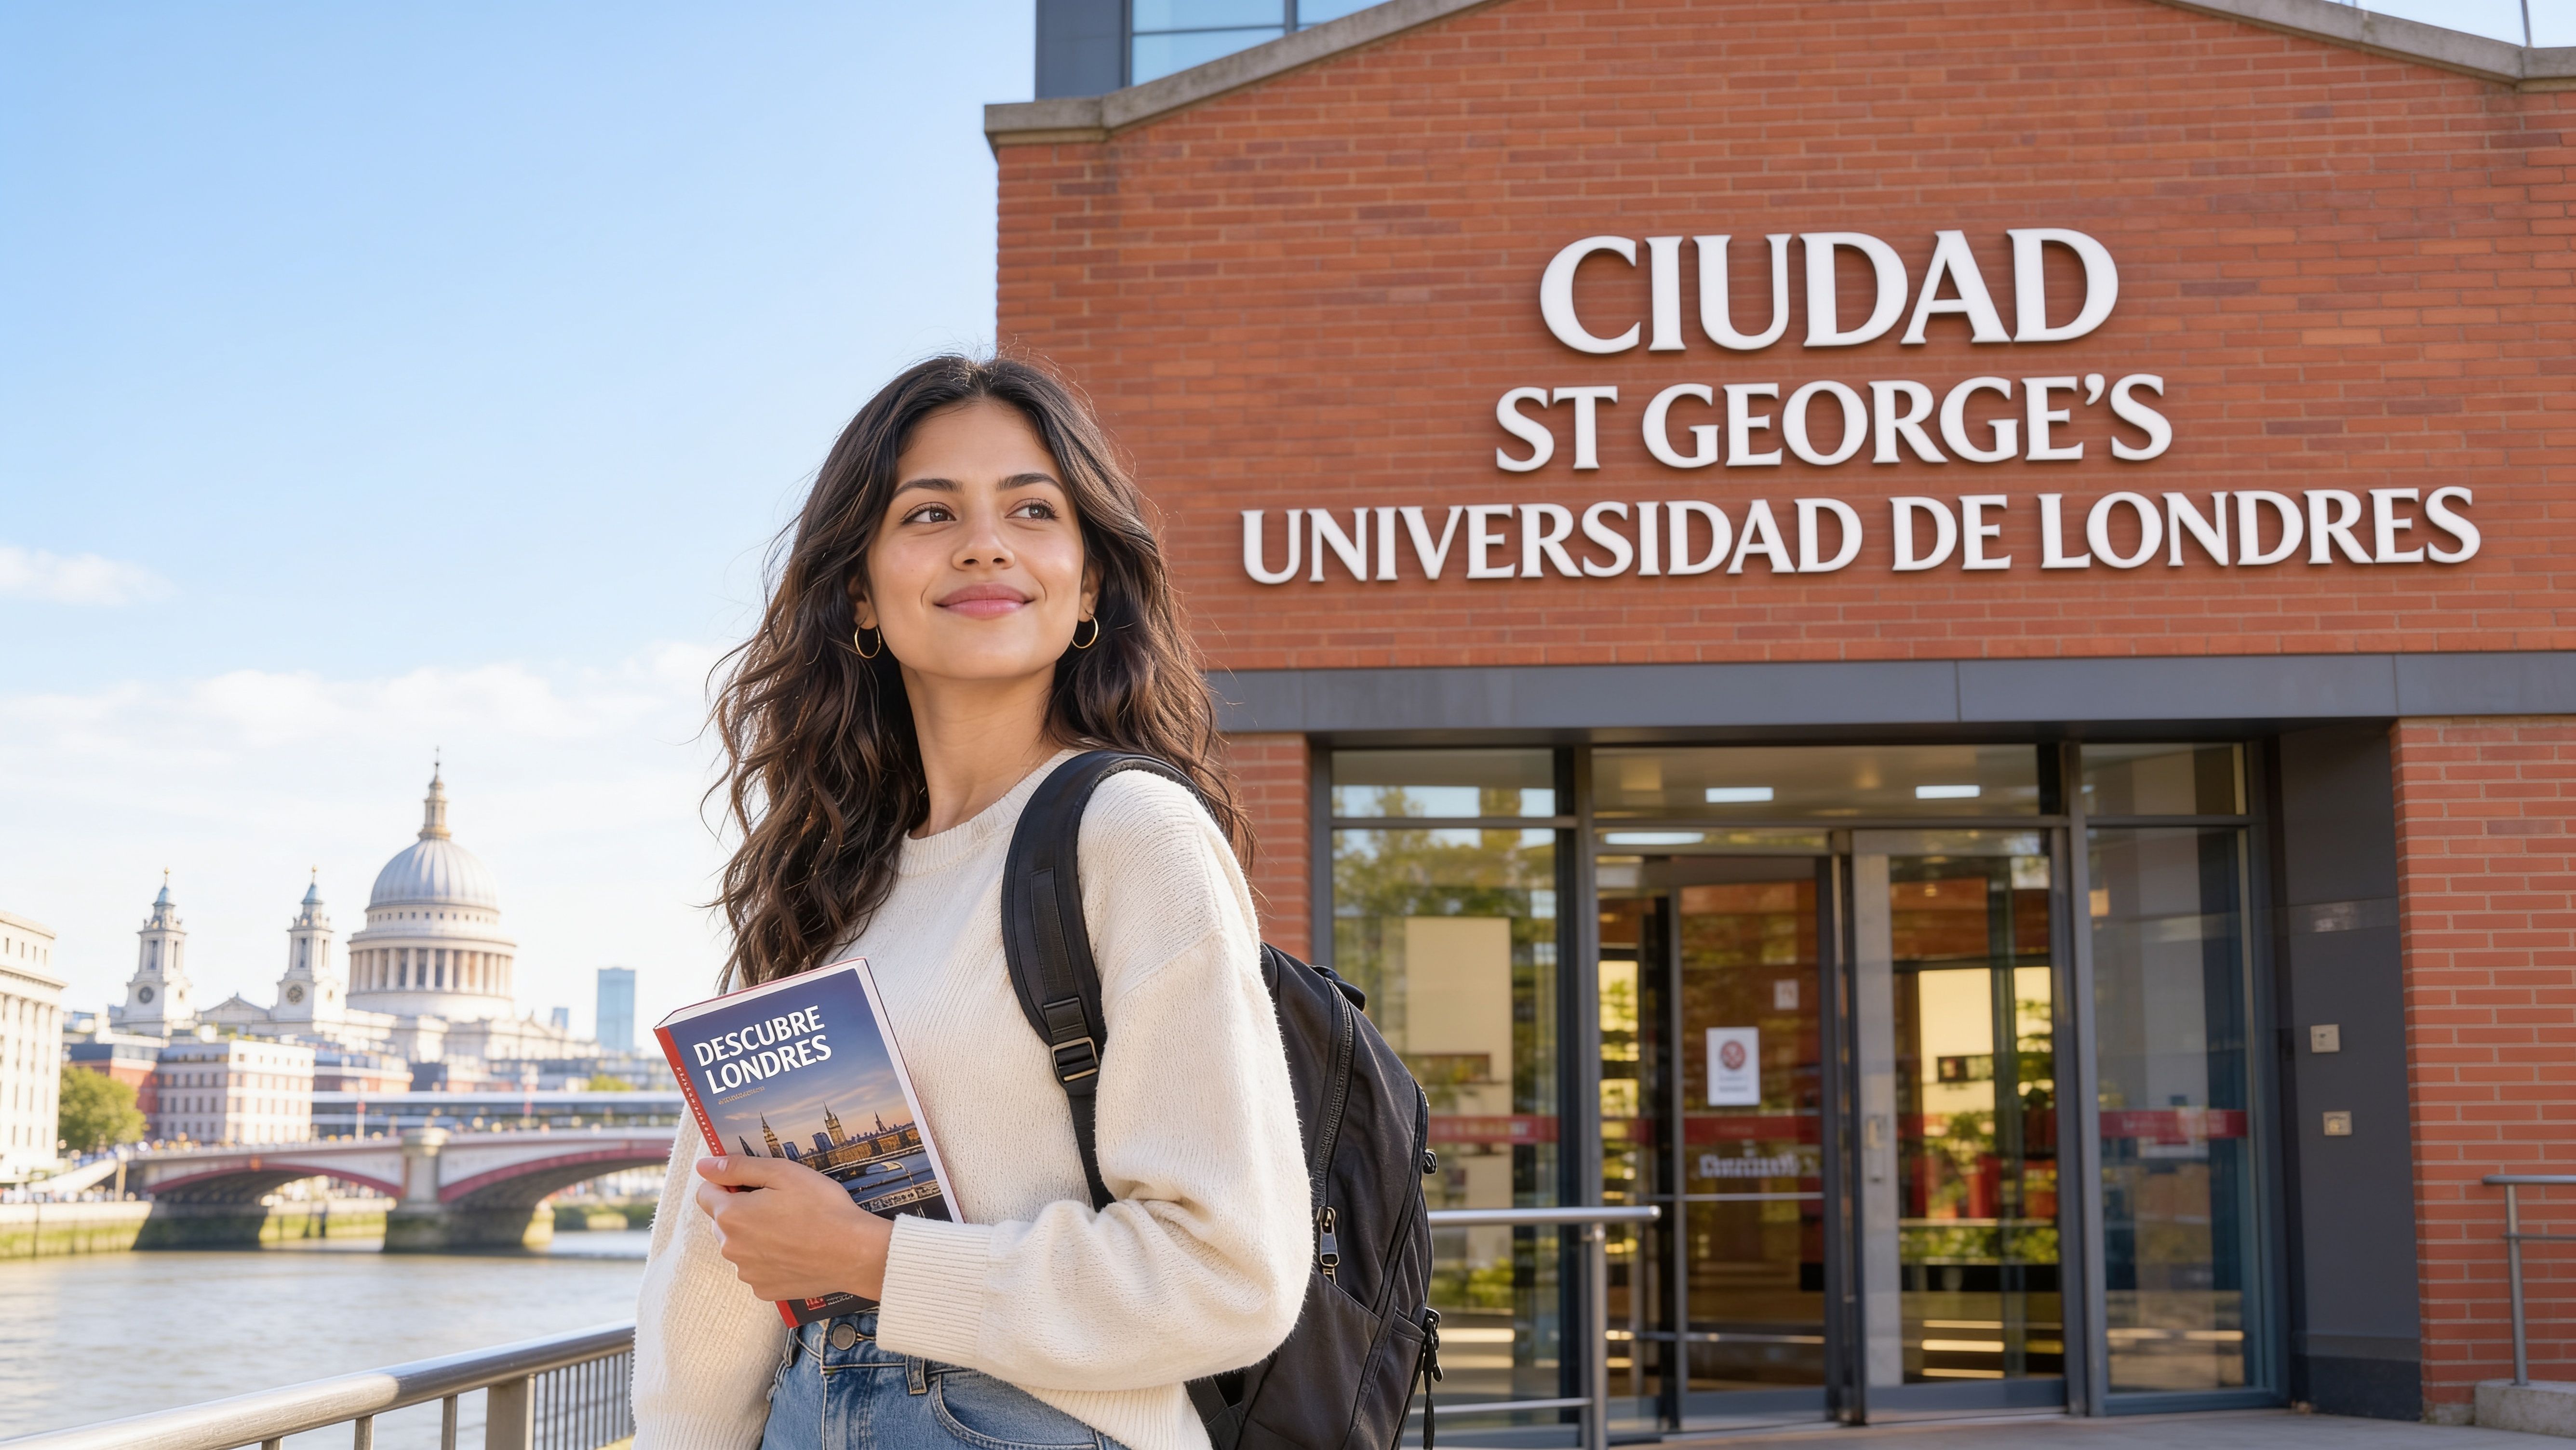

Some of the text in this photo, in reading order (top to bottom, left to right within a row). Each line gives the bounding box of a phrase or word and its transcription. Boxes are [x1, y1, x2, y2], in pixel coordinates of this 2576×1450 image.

[1540, 228, 2119, 354] CIUDAD
[1496, 373, 2173, 472] ST GEORGE’S
[1240, 485, 2482, 584] UNIVERSIDAD DE LONDRES
[693, 1005, 825, 1067] DESCUBRE
[705, 1034, 832, 1095] LONDRES
